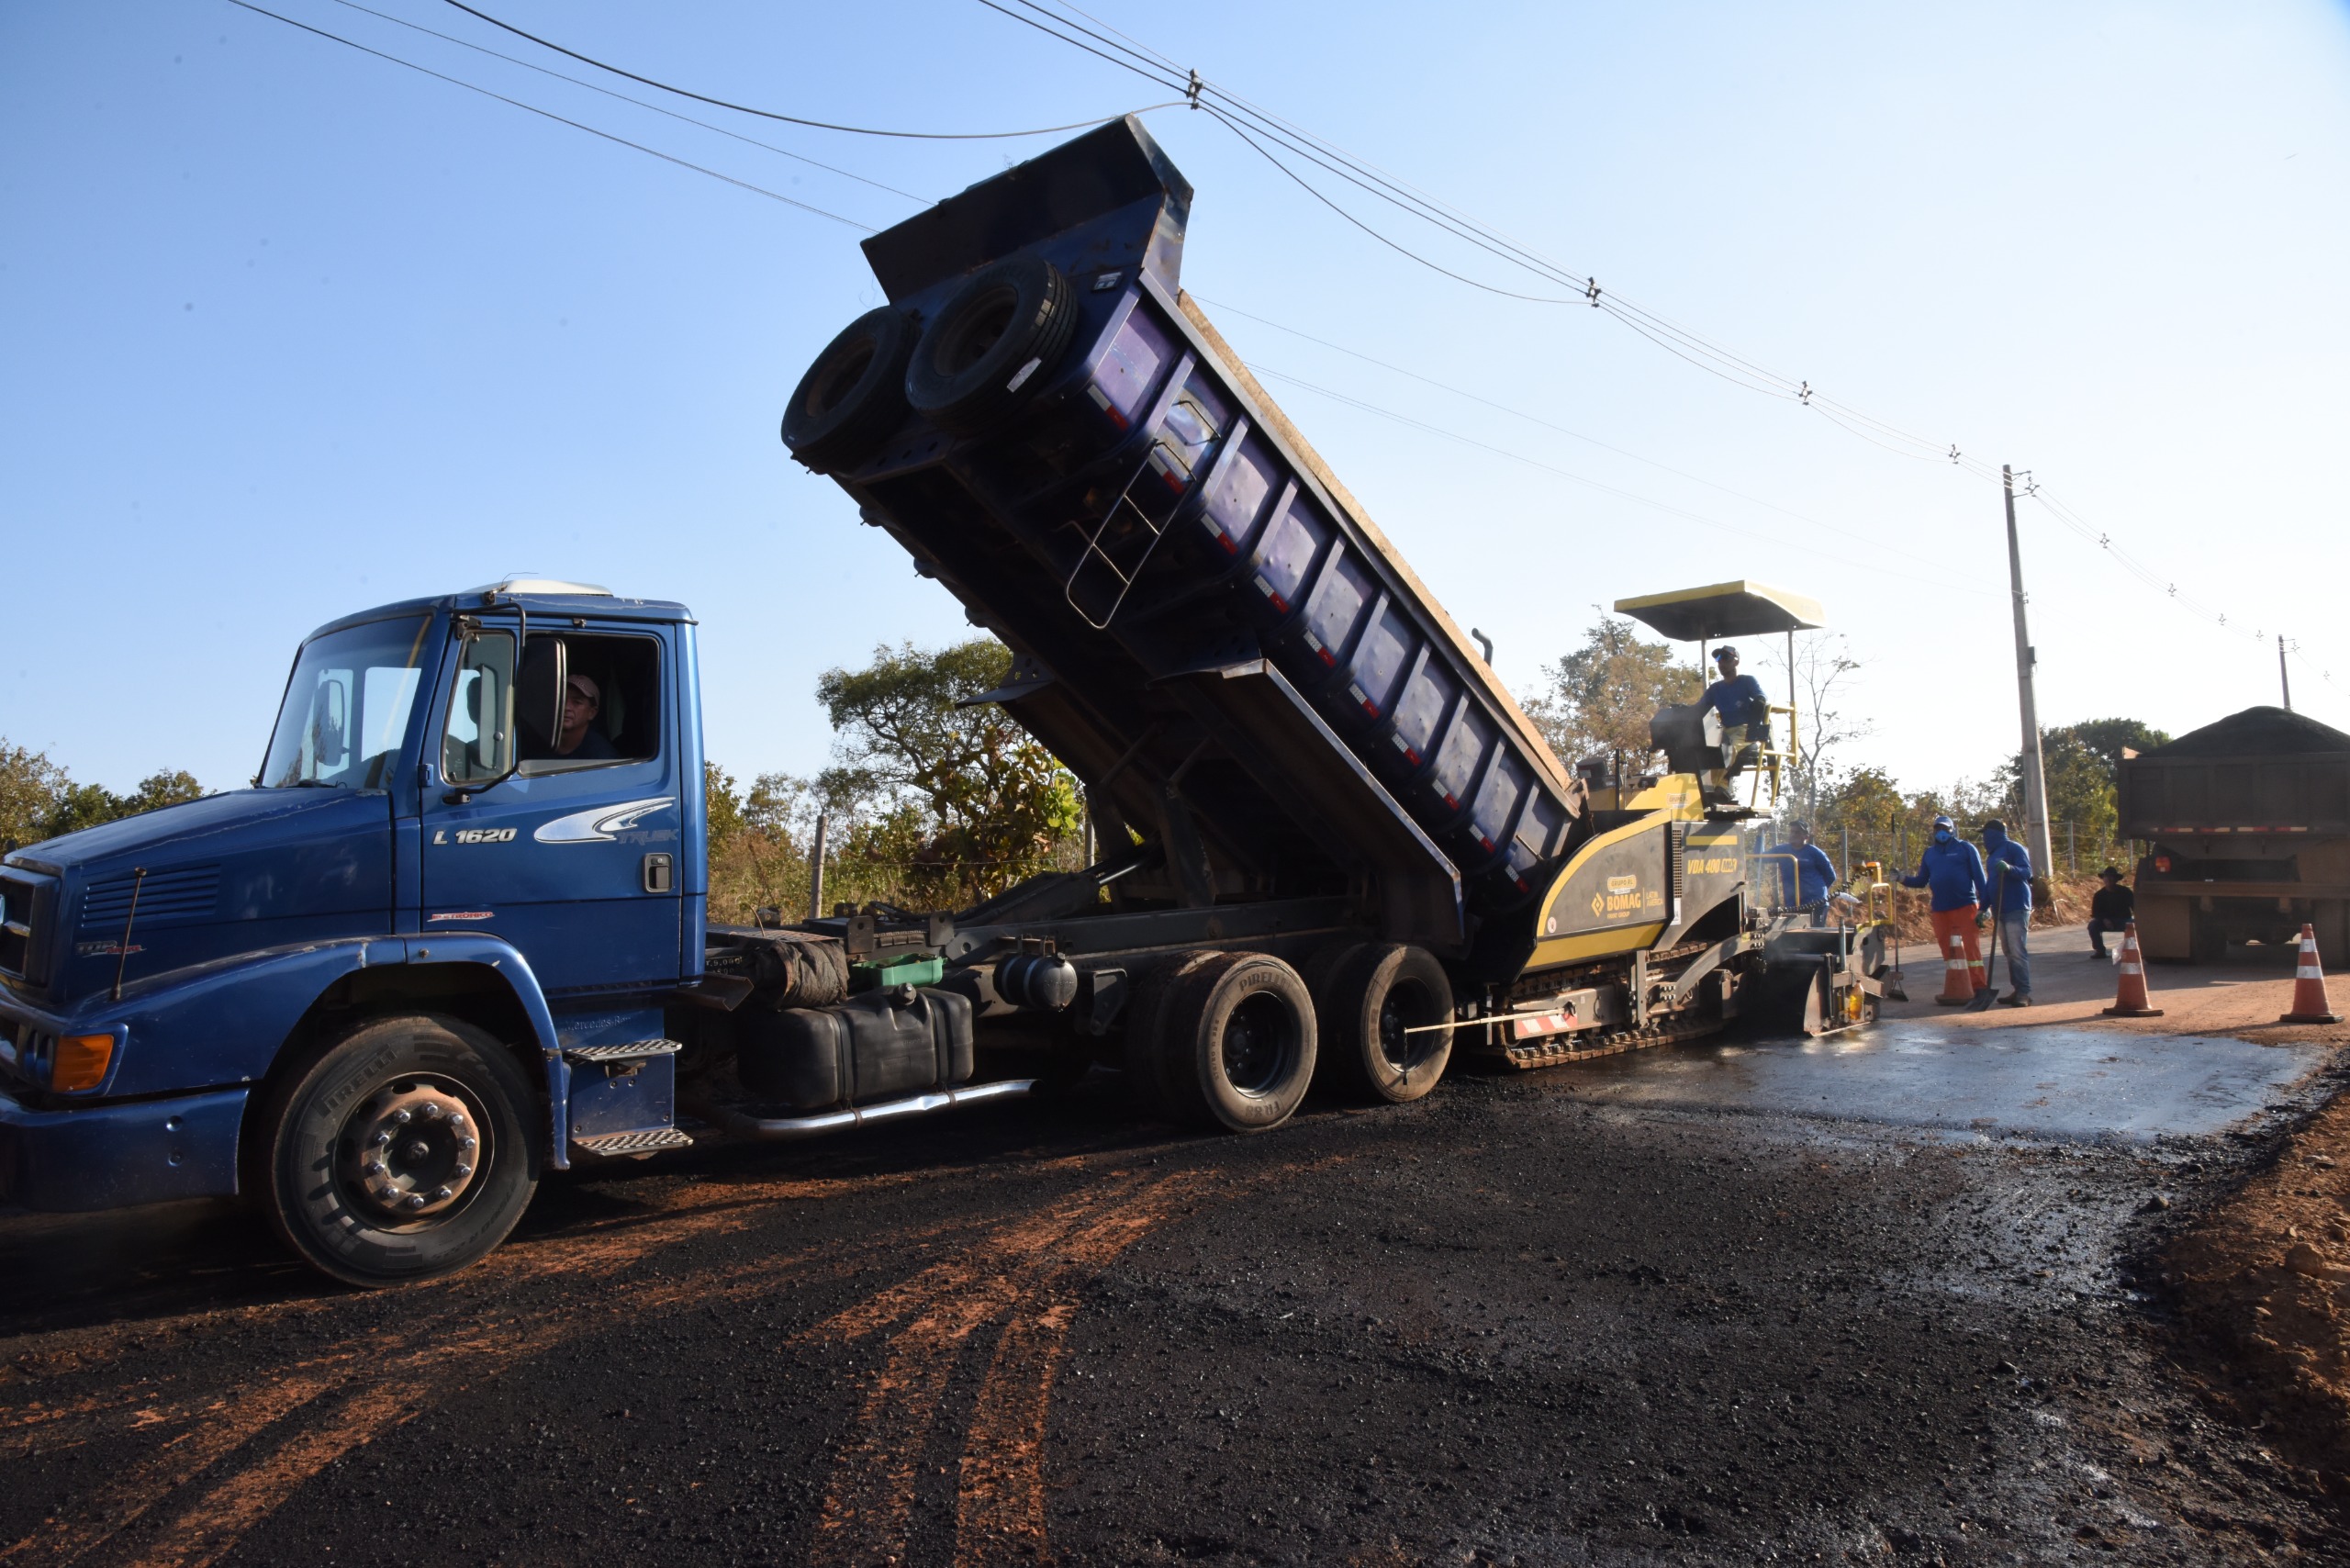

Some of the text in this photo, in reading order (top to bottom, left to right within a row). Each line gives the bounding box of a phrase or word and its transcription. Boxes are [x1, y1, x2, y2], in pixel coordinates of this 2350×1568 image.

[432, 828, 518, 846] L 1620
[1687, 858, 1705, 875] VDA
[1705, 857, 1721, 874] 400
[1610, 879, 1628, 887] GRUPO
[1606, 892, 1641, 912] BOMAG
[75, 940, 118, 956] TOP
